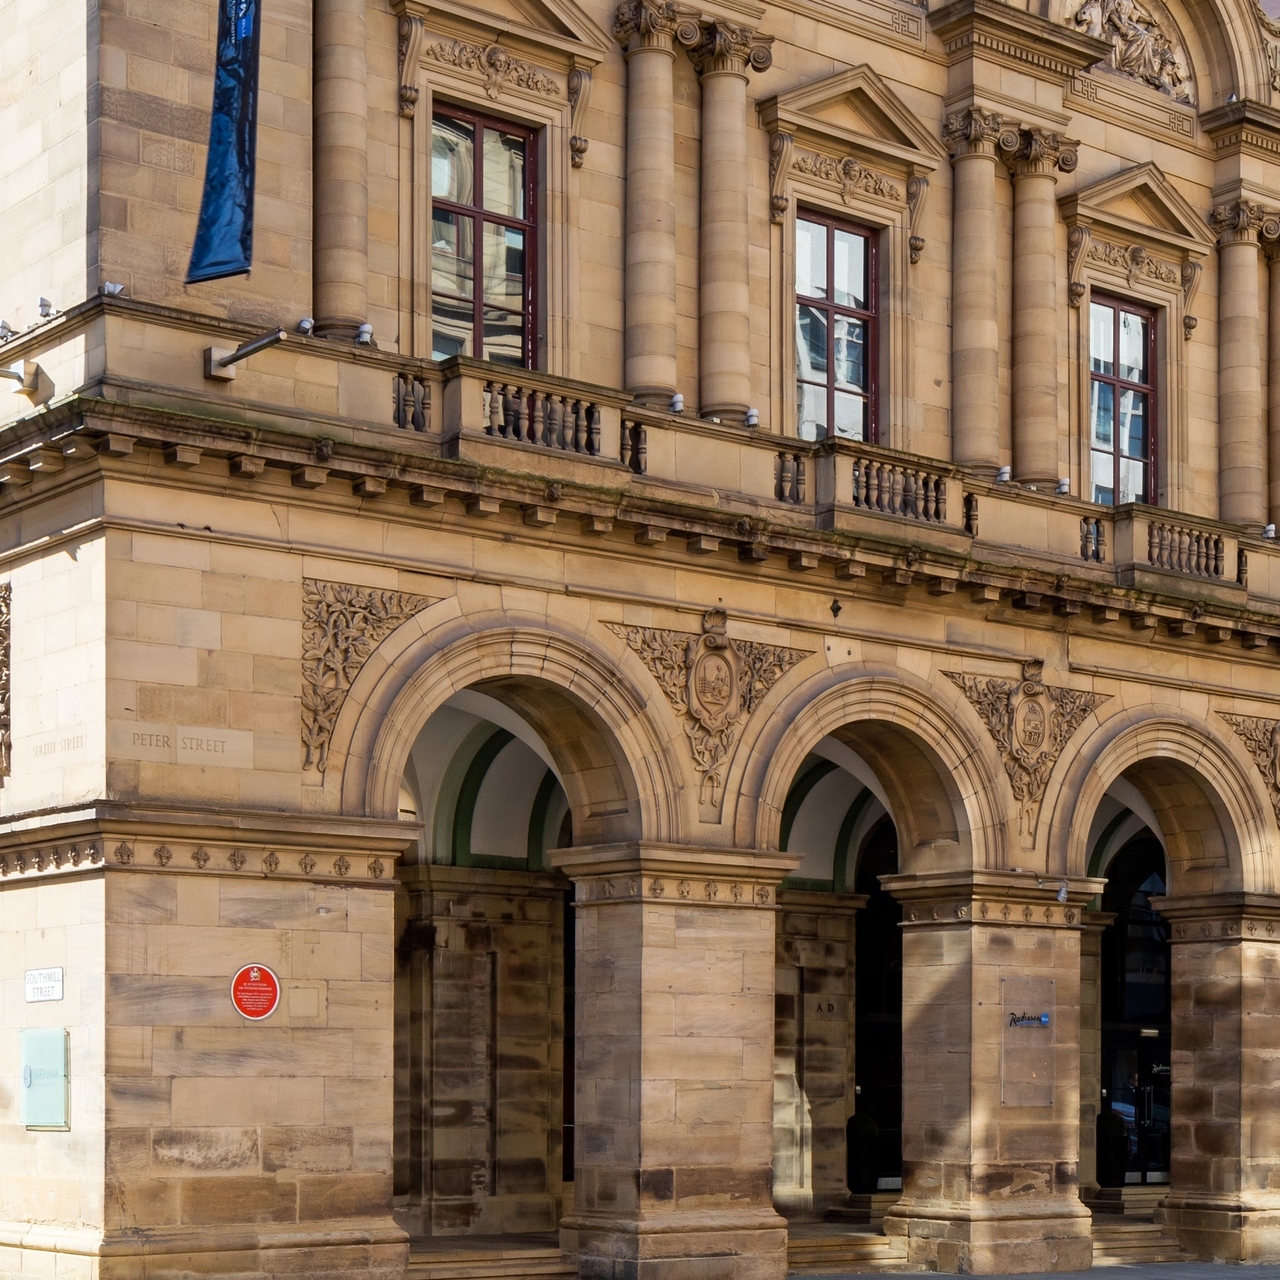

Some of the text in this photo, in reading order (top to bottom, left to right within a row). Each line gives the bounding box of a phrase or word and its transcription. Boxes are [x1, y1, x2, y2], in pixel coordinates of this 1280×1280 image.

[32, 735, 84, 757] SOUTH STREET
[132, 732, 227, 753] PETER STREET
[26, 971, 61, 985] SOUTHMILL
[32, 986, 55, 998] STREET
[1009, 1011, 1041, 1027] Radisson
